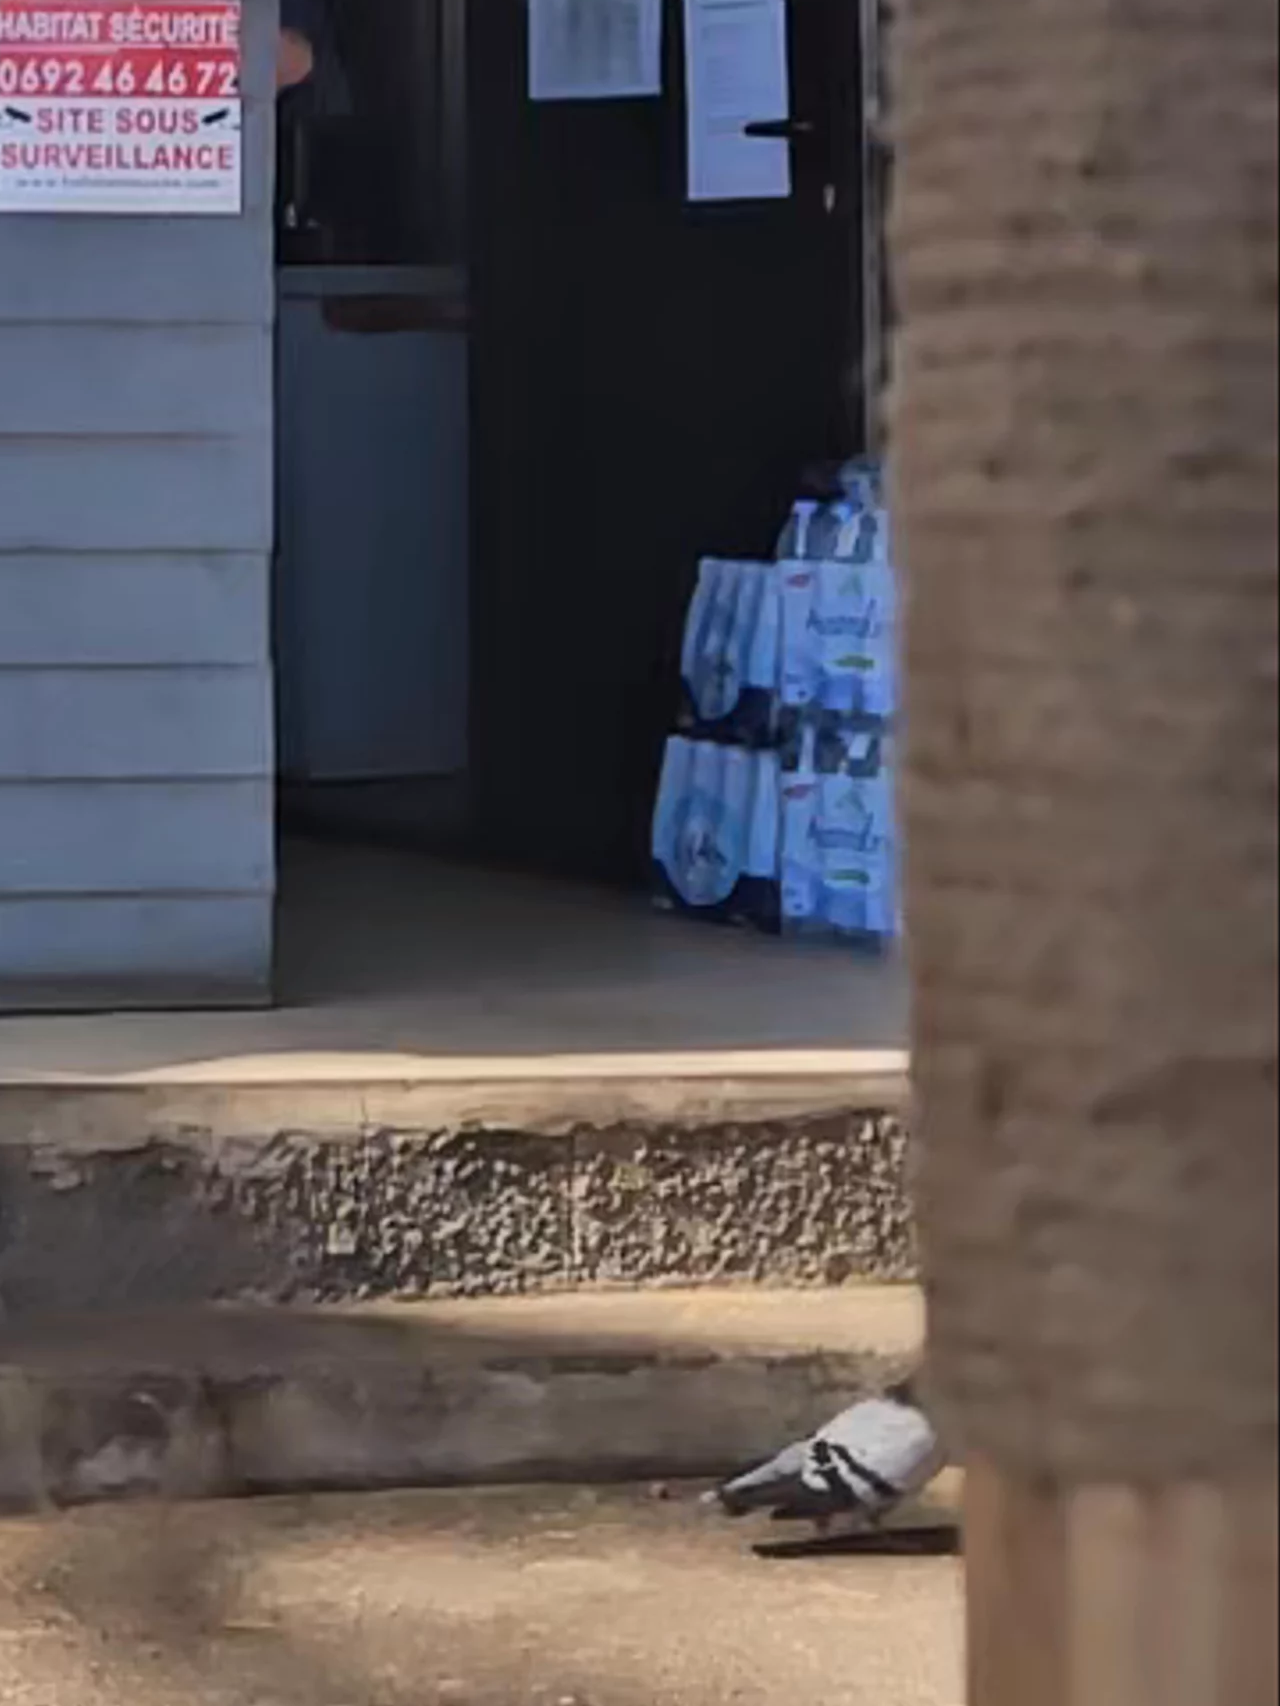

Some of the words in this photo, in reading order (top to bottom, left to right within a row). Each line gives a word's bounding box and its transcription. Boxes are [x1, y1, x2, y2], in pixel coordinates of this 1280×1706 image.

[109, 3, 239, 45] SÉCURITÉ
[92, 58, 136, 94] 46
[144, 60, 188, 95] 46
[195, 61, 239, 96] 72
[36, 107, 105, 135] SITE
[115, 107, 200, 135] SOUS
[0, 142, 235, 171] SURVEILLANCE
